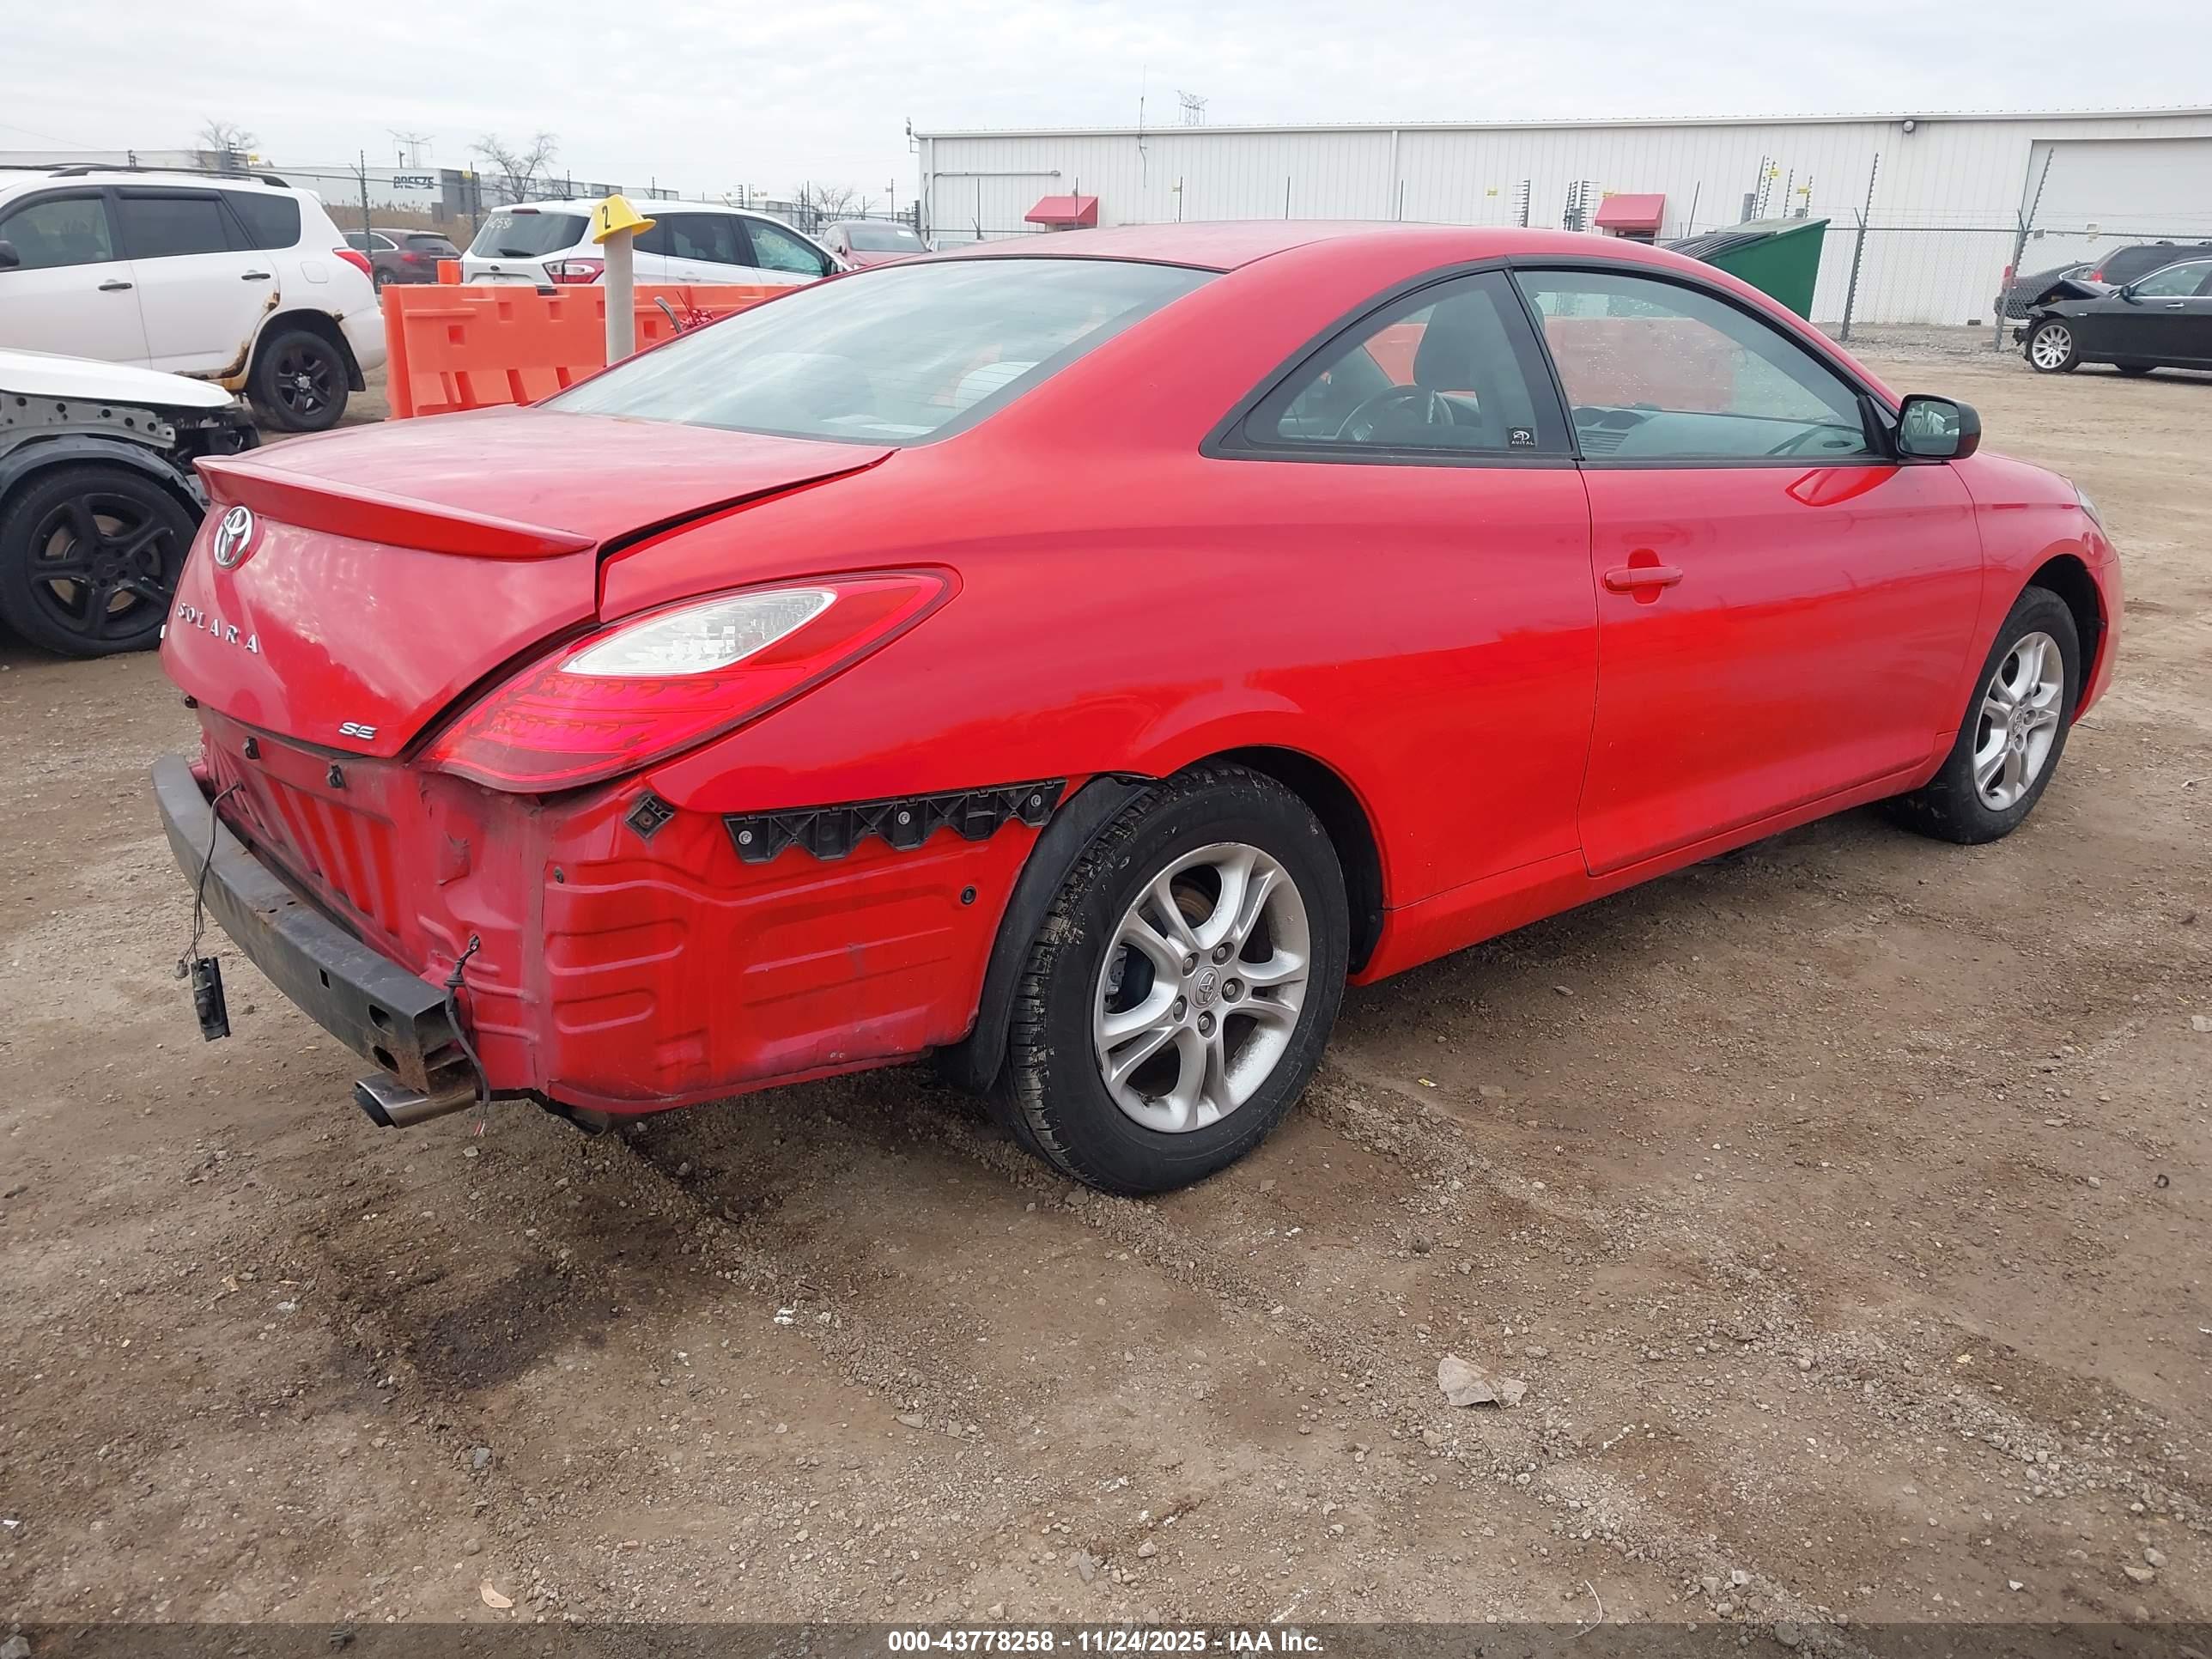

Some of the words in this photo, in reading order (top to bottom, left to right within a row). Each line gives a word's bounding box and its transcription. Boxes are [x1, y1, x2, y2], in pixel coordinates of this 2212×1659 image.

[602, 205, 611, 230] 2
[178, 602, 259, 653] SOLARA
[338, 721, 378, 739] SE
